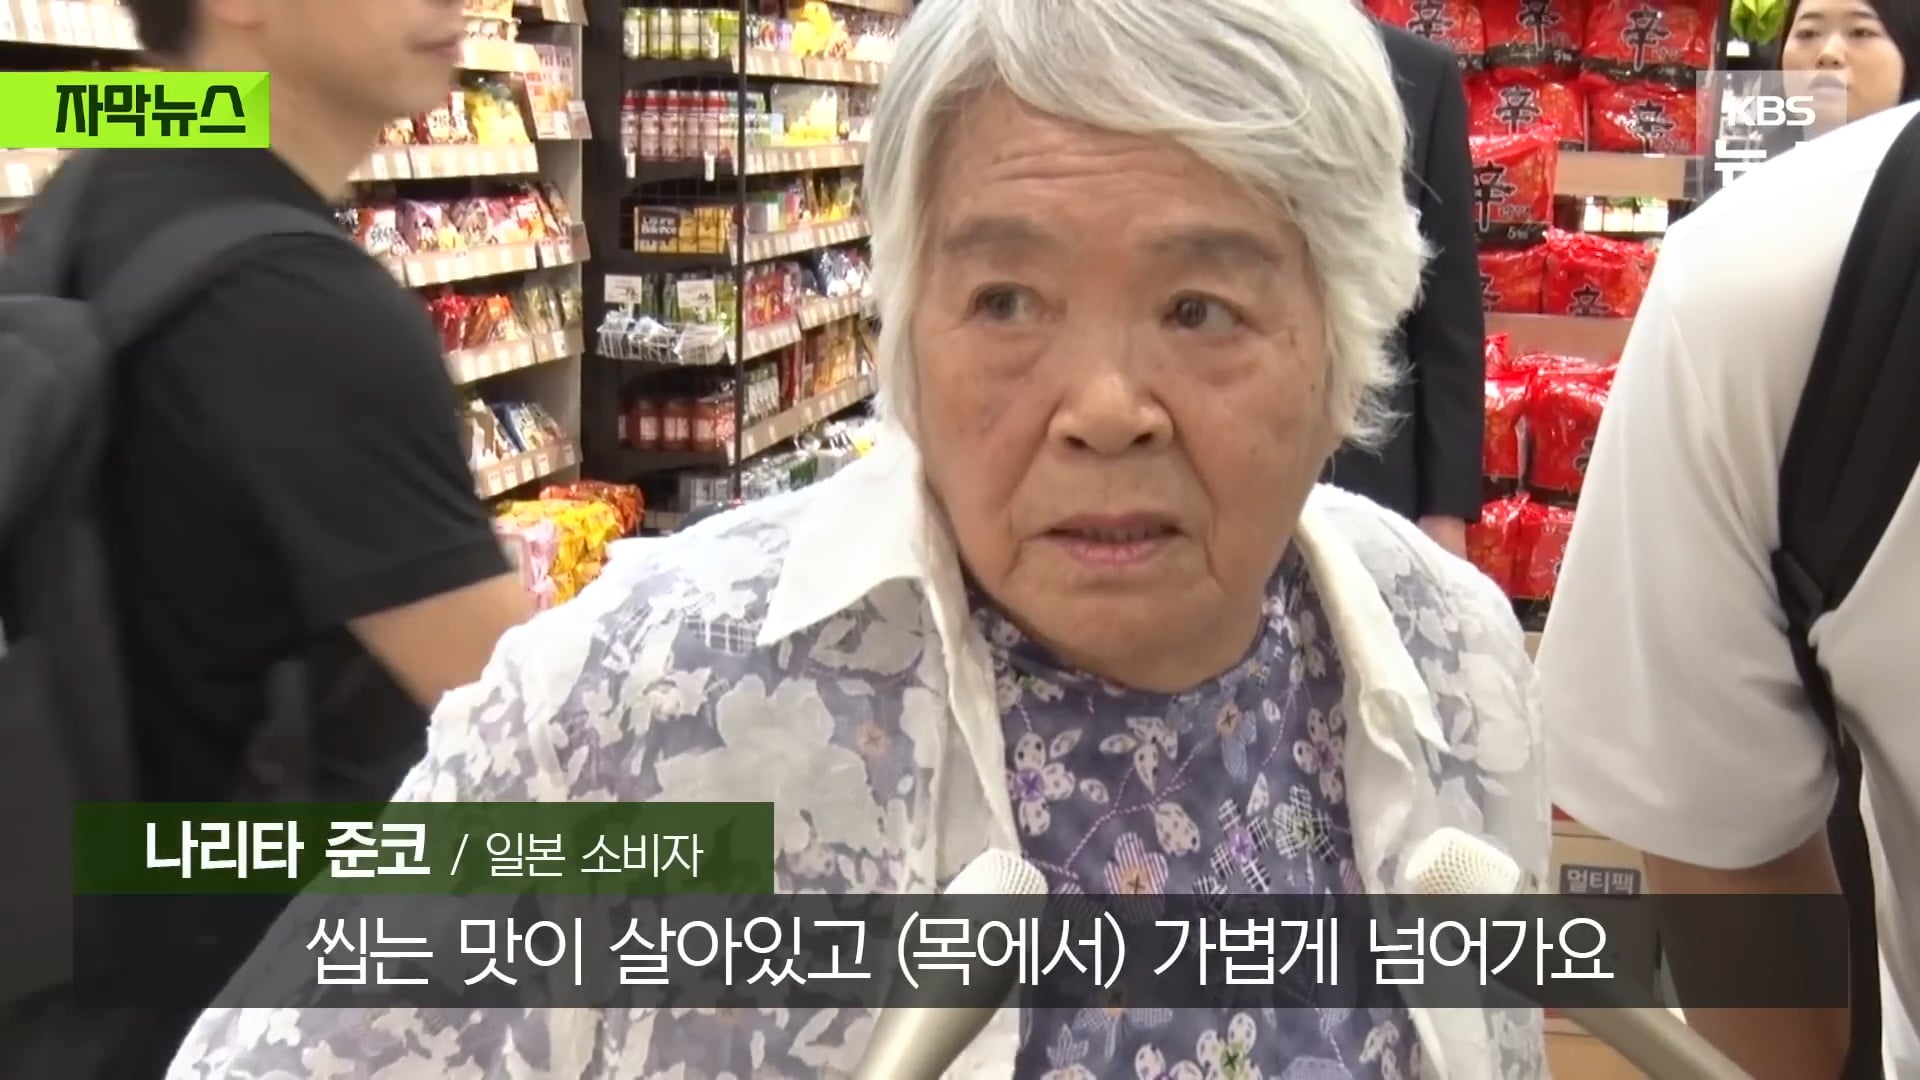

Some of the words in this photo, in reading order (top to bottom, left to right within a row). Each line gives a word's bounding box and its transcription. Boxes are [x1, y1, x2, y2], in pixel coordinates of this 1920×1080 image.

[1621, 3, 1671, 72] 辛
[1473, 159, 1517, 233] 辛
[1566, 868, 1635, 896] 멀티팩
